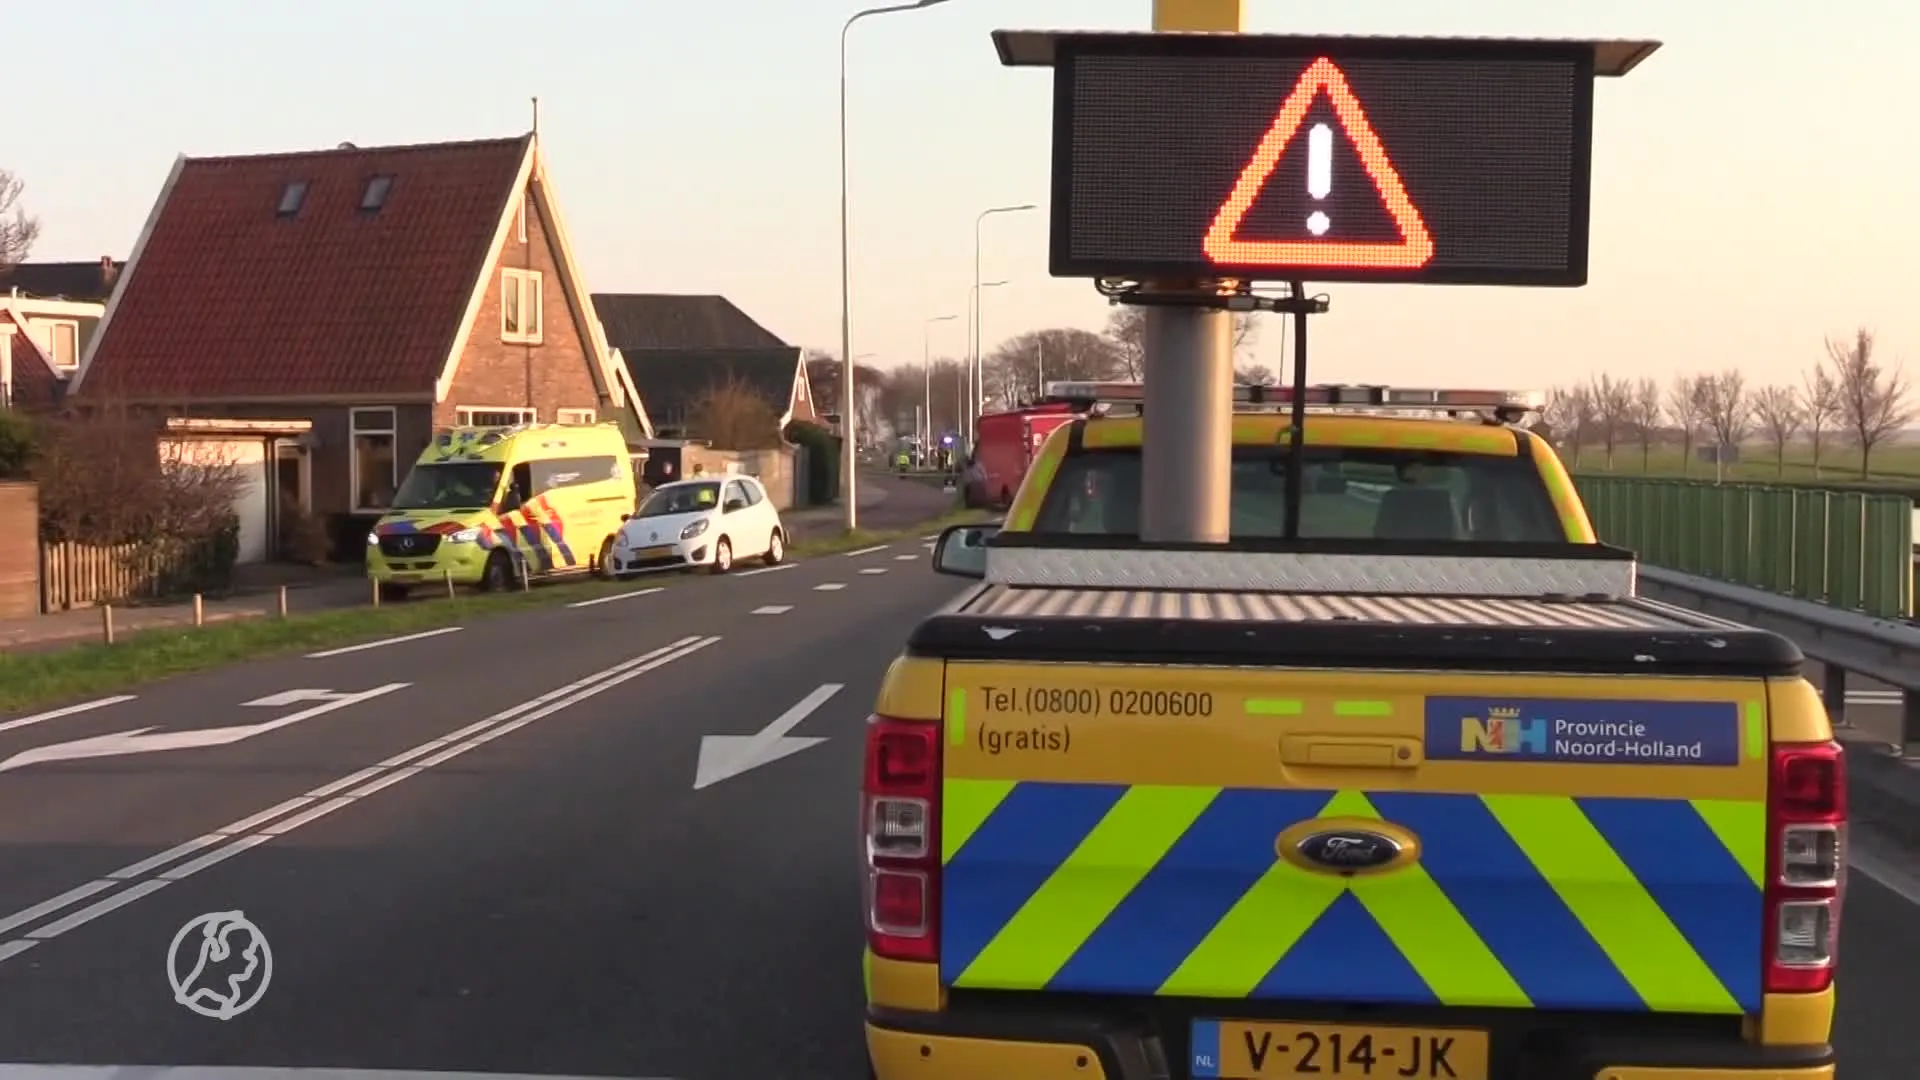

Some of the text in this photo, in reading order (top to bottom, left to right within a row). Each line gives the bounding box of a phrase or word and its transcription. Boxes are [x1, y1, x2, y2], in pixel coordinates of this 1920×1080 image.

[1109, 690, 1213, 717] 0200600
[979, 722, 1070, 755] (gratis)
[1555, 719, 1646, 738] Provincie
[1555, 740, 1702, 758] Noord-Holland
[1196, 1054, 1214, 1067] NL
[1244, 1031, 1457, 1078] V-214-JK
